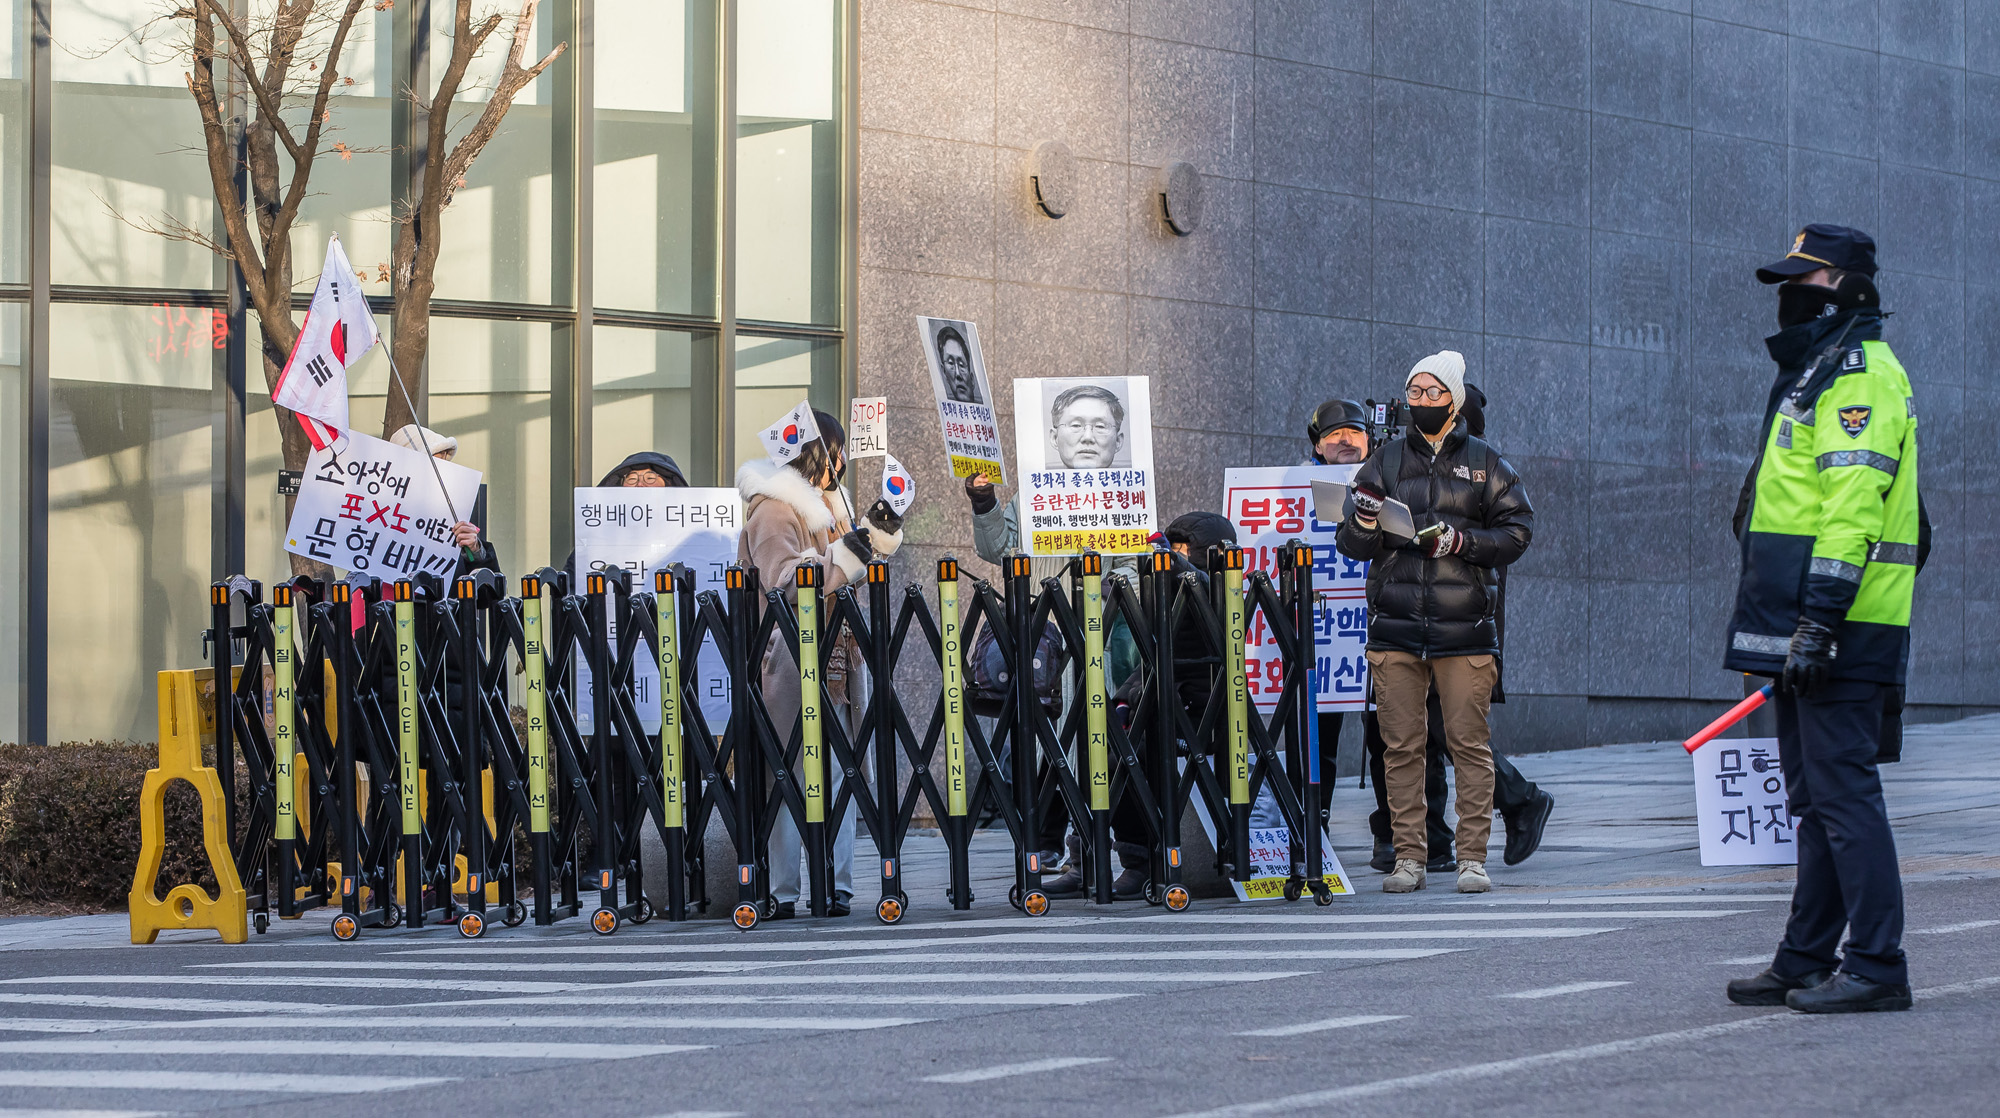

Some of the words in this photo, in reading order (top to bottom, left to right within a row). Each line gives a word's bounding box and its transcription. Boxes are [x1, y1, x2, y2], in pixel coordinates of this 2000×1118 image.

[852, 402, 886, 423] STOP
[857, 424, 871, 433] THE
[851, 435, 885, 453] STEAL
[315, 452, 411, 498] 소아성애
[1071, 472, 1094, 487] 졸속
[1099, 470, 1146, 487] 탄핵심리
[581, 504, 653, 528] 행배야
[666, 504, 735, 528] 더러워
[1032, 515, 1066, 528] 행배야,
[1068, 514, 1109, 527] 행번방서
[1034, 533, 1083, 550] 우리법회장
[1087, 533, 1117, 550] 출신은
[661, 636, 674, 726] POLICE
[946, 624, 959, 714] POLICE
[1231, 612, 1244, 702] POLICE
[399, 644, 412, 734] POLICE
[800, 629, 821, 798] 질서유지선
[1088, 618, 1107, 785] 질서유지선
[276, 649, 292, 816] 질서유지선
[526, 640, 545, 808] 질서유지선
[1236, 720, 1246, 779] LINE
[404, 752, 414, 810] LINE
[667, 744, 676, 803] LINE
[952, 733, 962, 791] LINE
